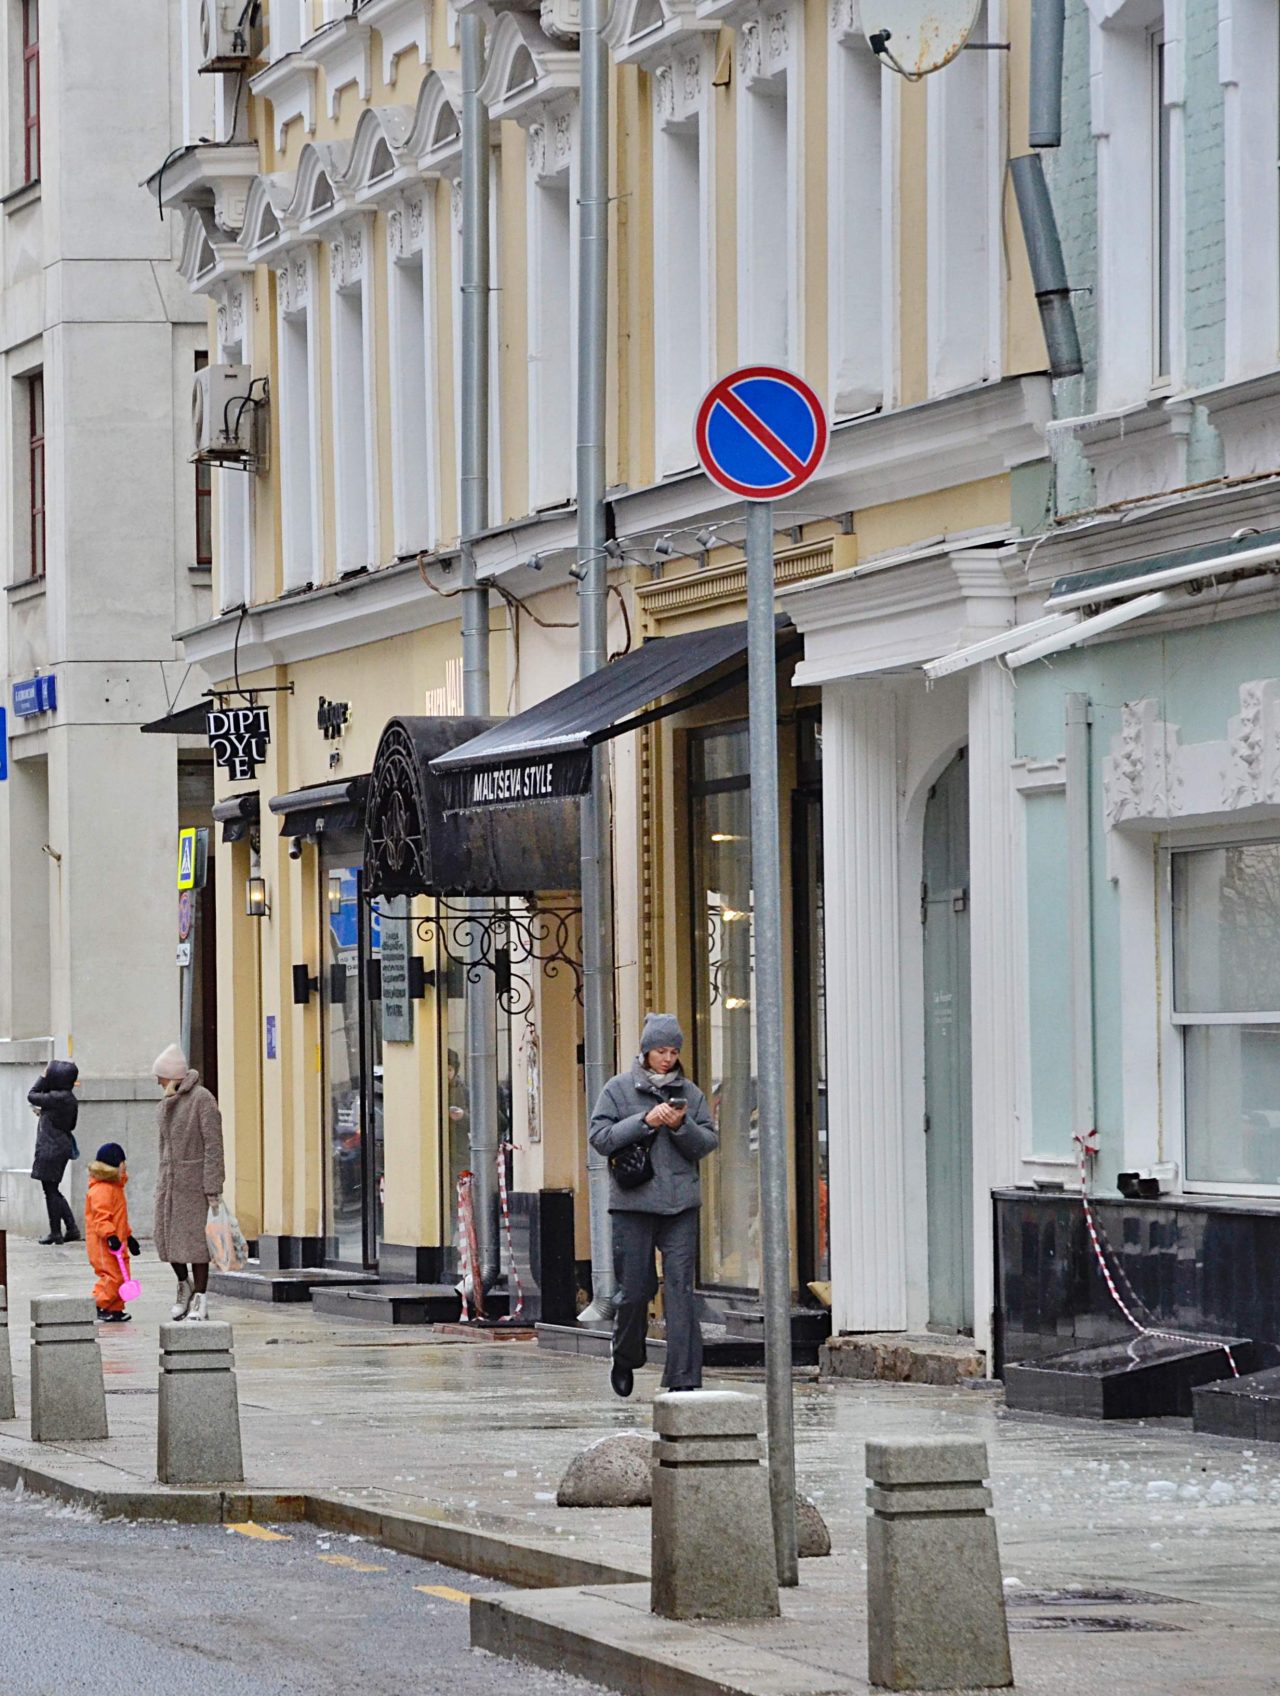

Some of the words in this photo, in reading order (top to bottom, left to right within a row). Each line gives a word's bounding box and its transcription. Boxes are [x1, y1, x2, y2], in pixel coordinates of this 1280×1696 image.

[207, 708, 269, 736] DIPT
[473, 767, 521, 801] MALTSEVA
[523, 763, 553, 797] STYLE
